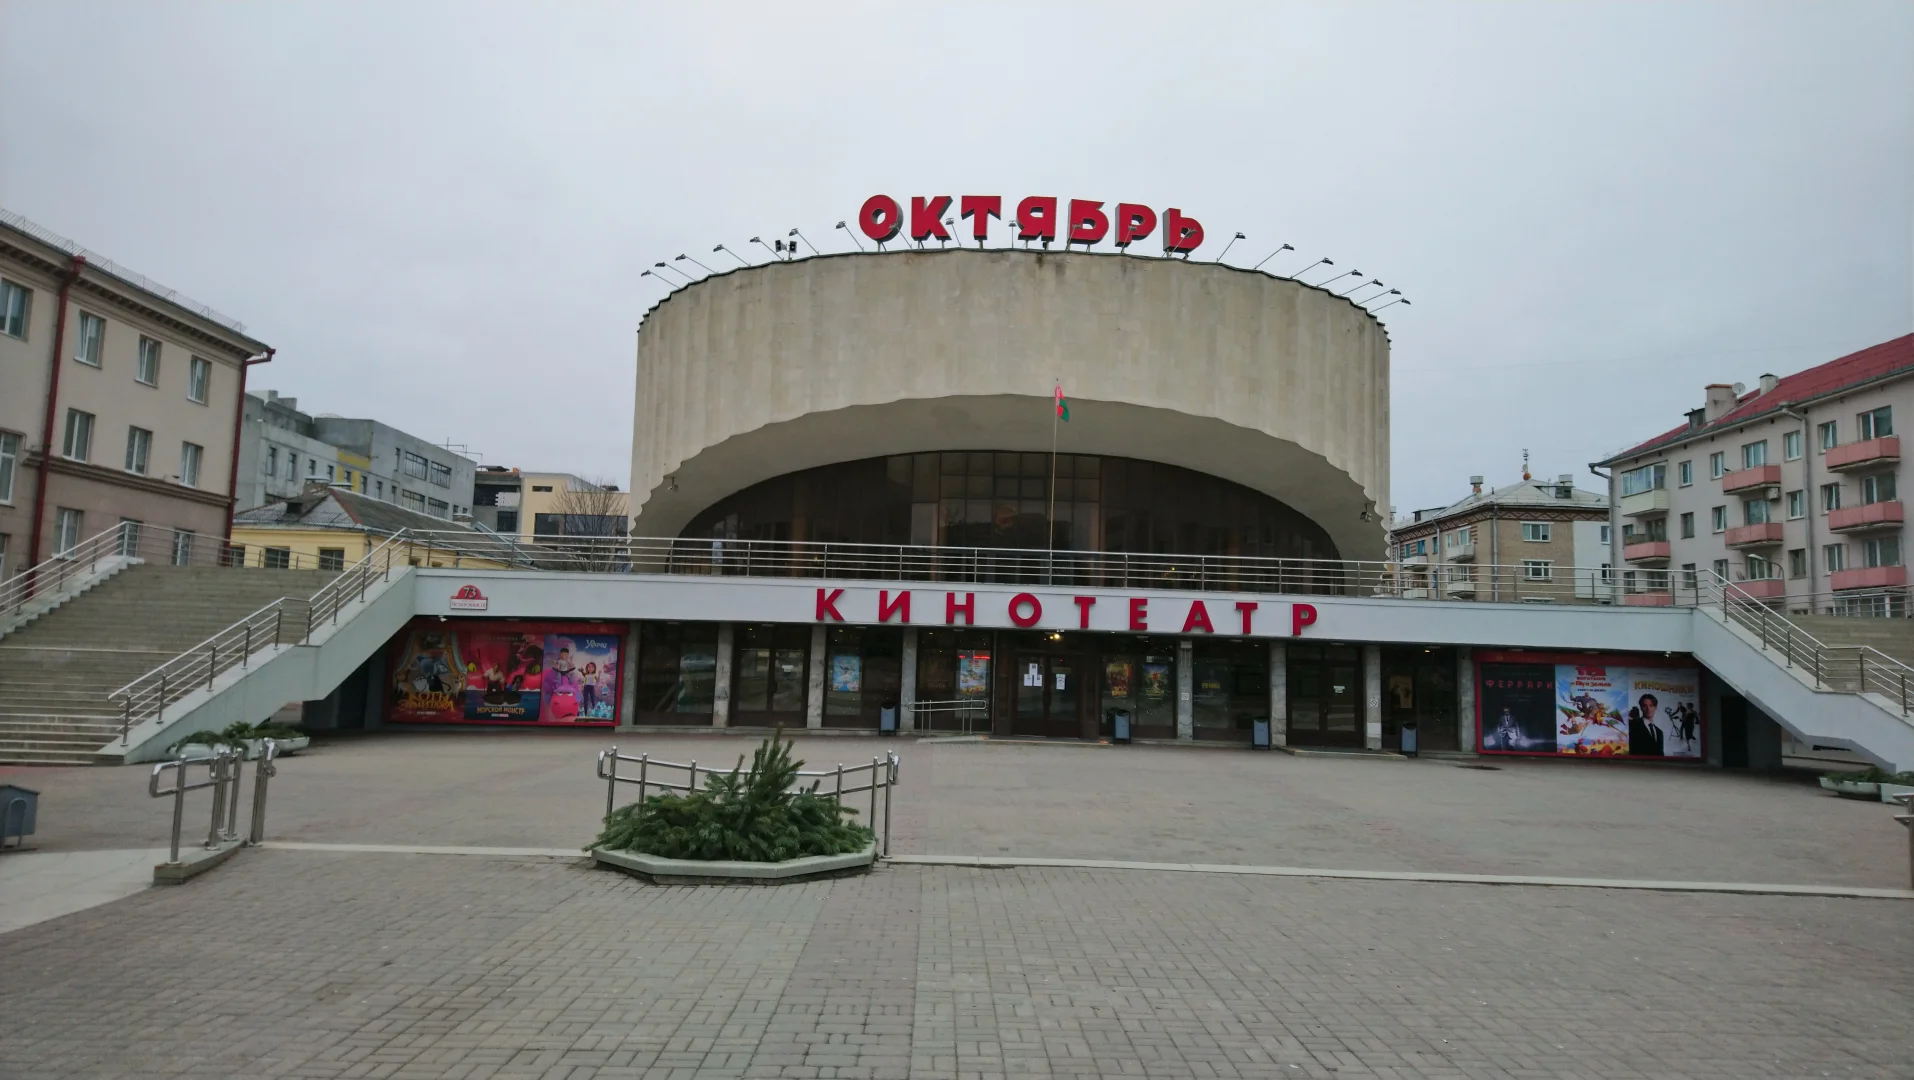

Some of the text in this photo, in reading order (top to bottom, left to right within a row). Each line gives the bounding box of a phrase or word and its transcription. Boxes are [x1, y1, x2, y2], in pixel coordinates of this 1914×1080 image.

[859, 194, 1205, 253] ОКТЯБРЬ
[463, 587, 477, 599] 73
[816, 588, 1318, 637] КИНОТЕАТР
[1485, 679, 1553, 689] ФЕРРАРИ
[1634, 680, 1695, 693] КИНОШНИКИ
